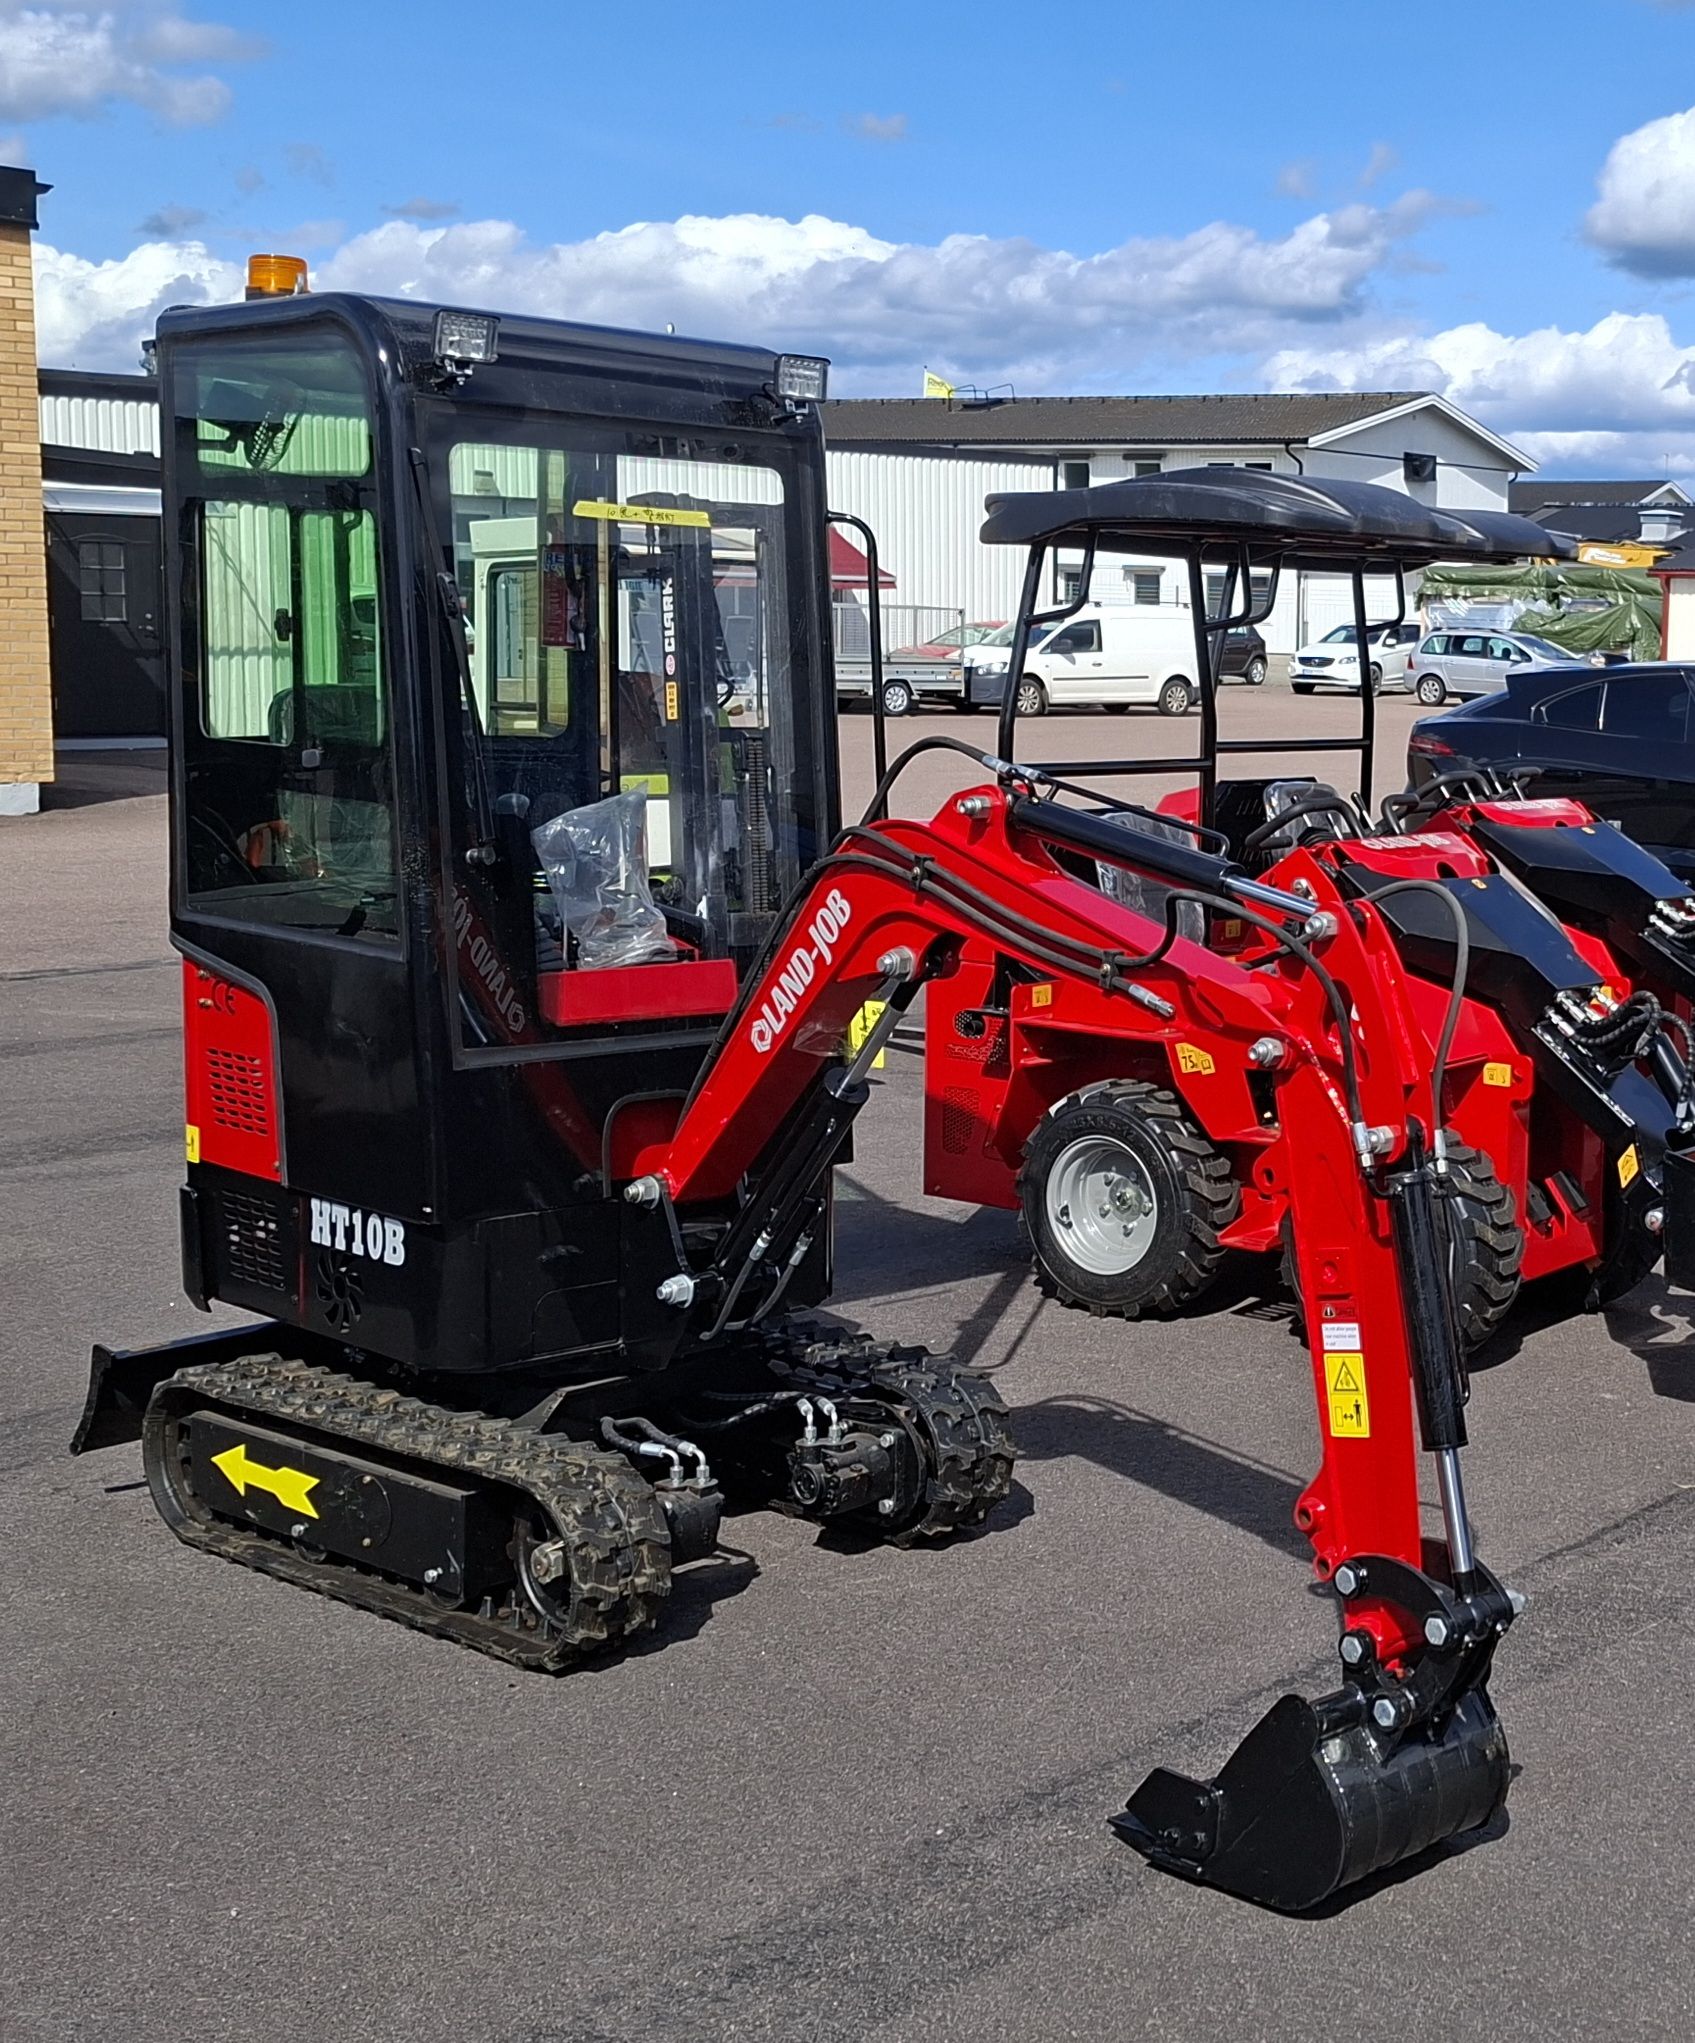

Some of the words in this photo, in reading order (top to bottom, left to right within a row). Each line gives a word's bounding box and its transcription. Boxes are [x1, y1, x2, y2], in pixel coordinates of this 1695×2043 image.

[662, 577, 676, 652] CLARK
[761, 889, 851, 1035] LAND-JOB
[310, 1198, 406, 1266] HT10B
